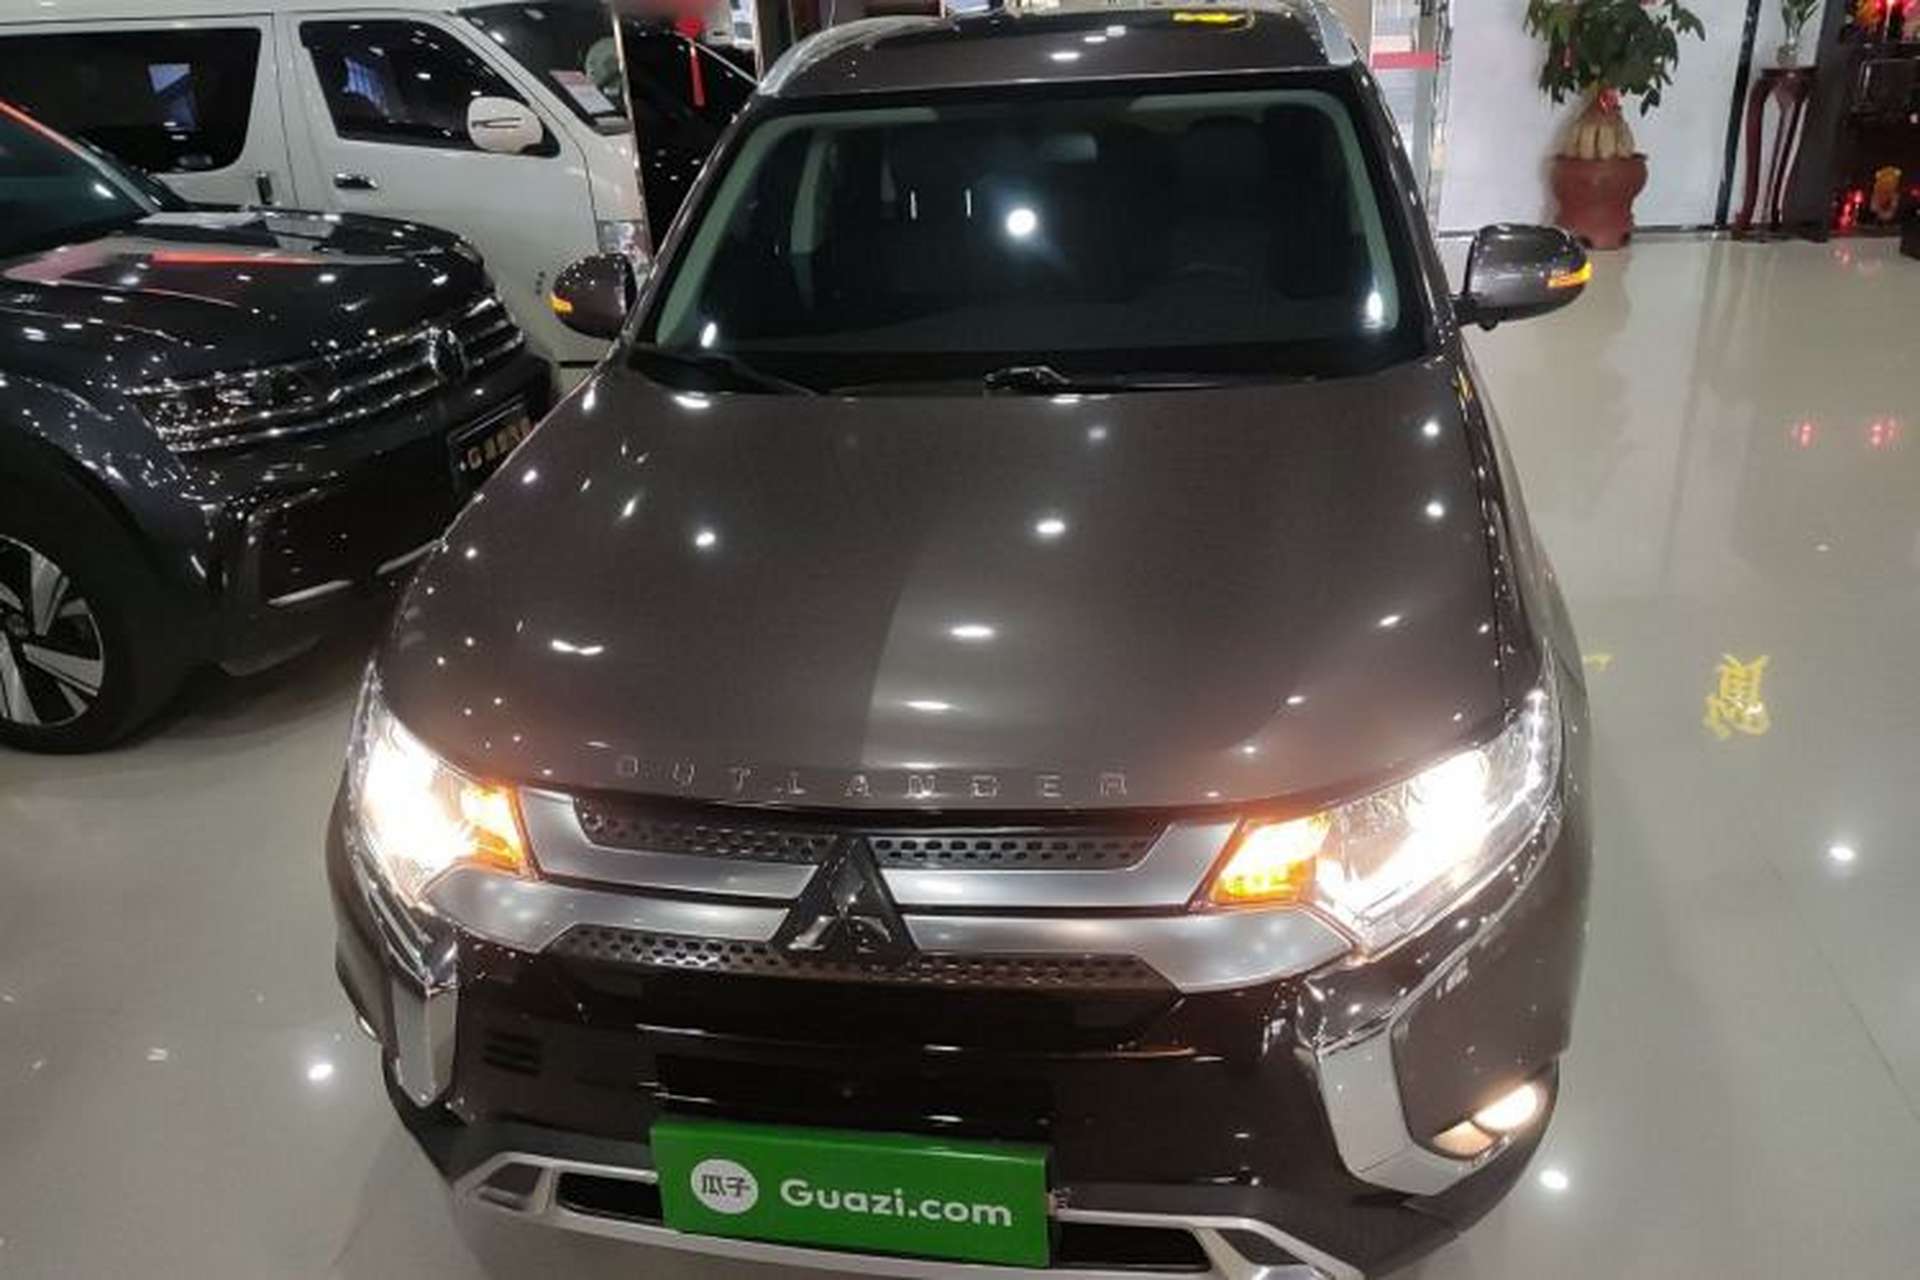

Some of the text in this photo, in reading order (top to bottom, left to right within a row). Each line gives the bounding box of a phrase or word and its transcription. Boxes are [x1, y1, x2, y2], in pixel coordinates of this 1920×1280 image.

[616, 756, 1127, 798] OUTLANDER
[702, 1174, 750, 1197] 瓜子
[780, 1178, 1012, 1227] Guazi.com
